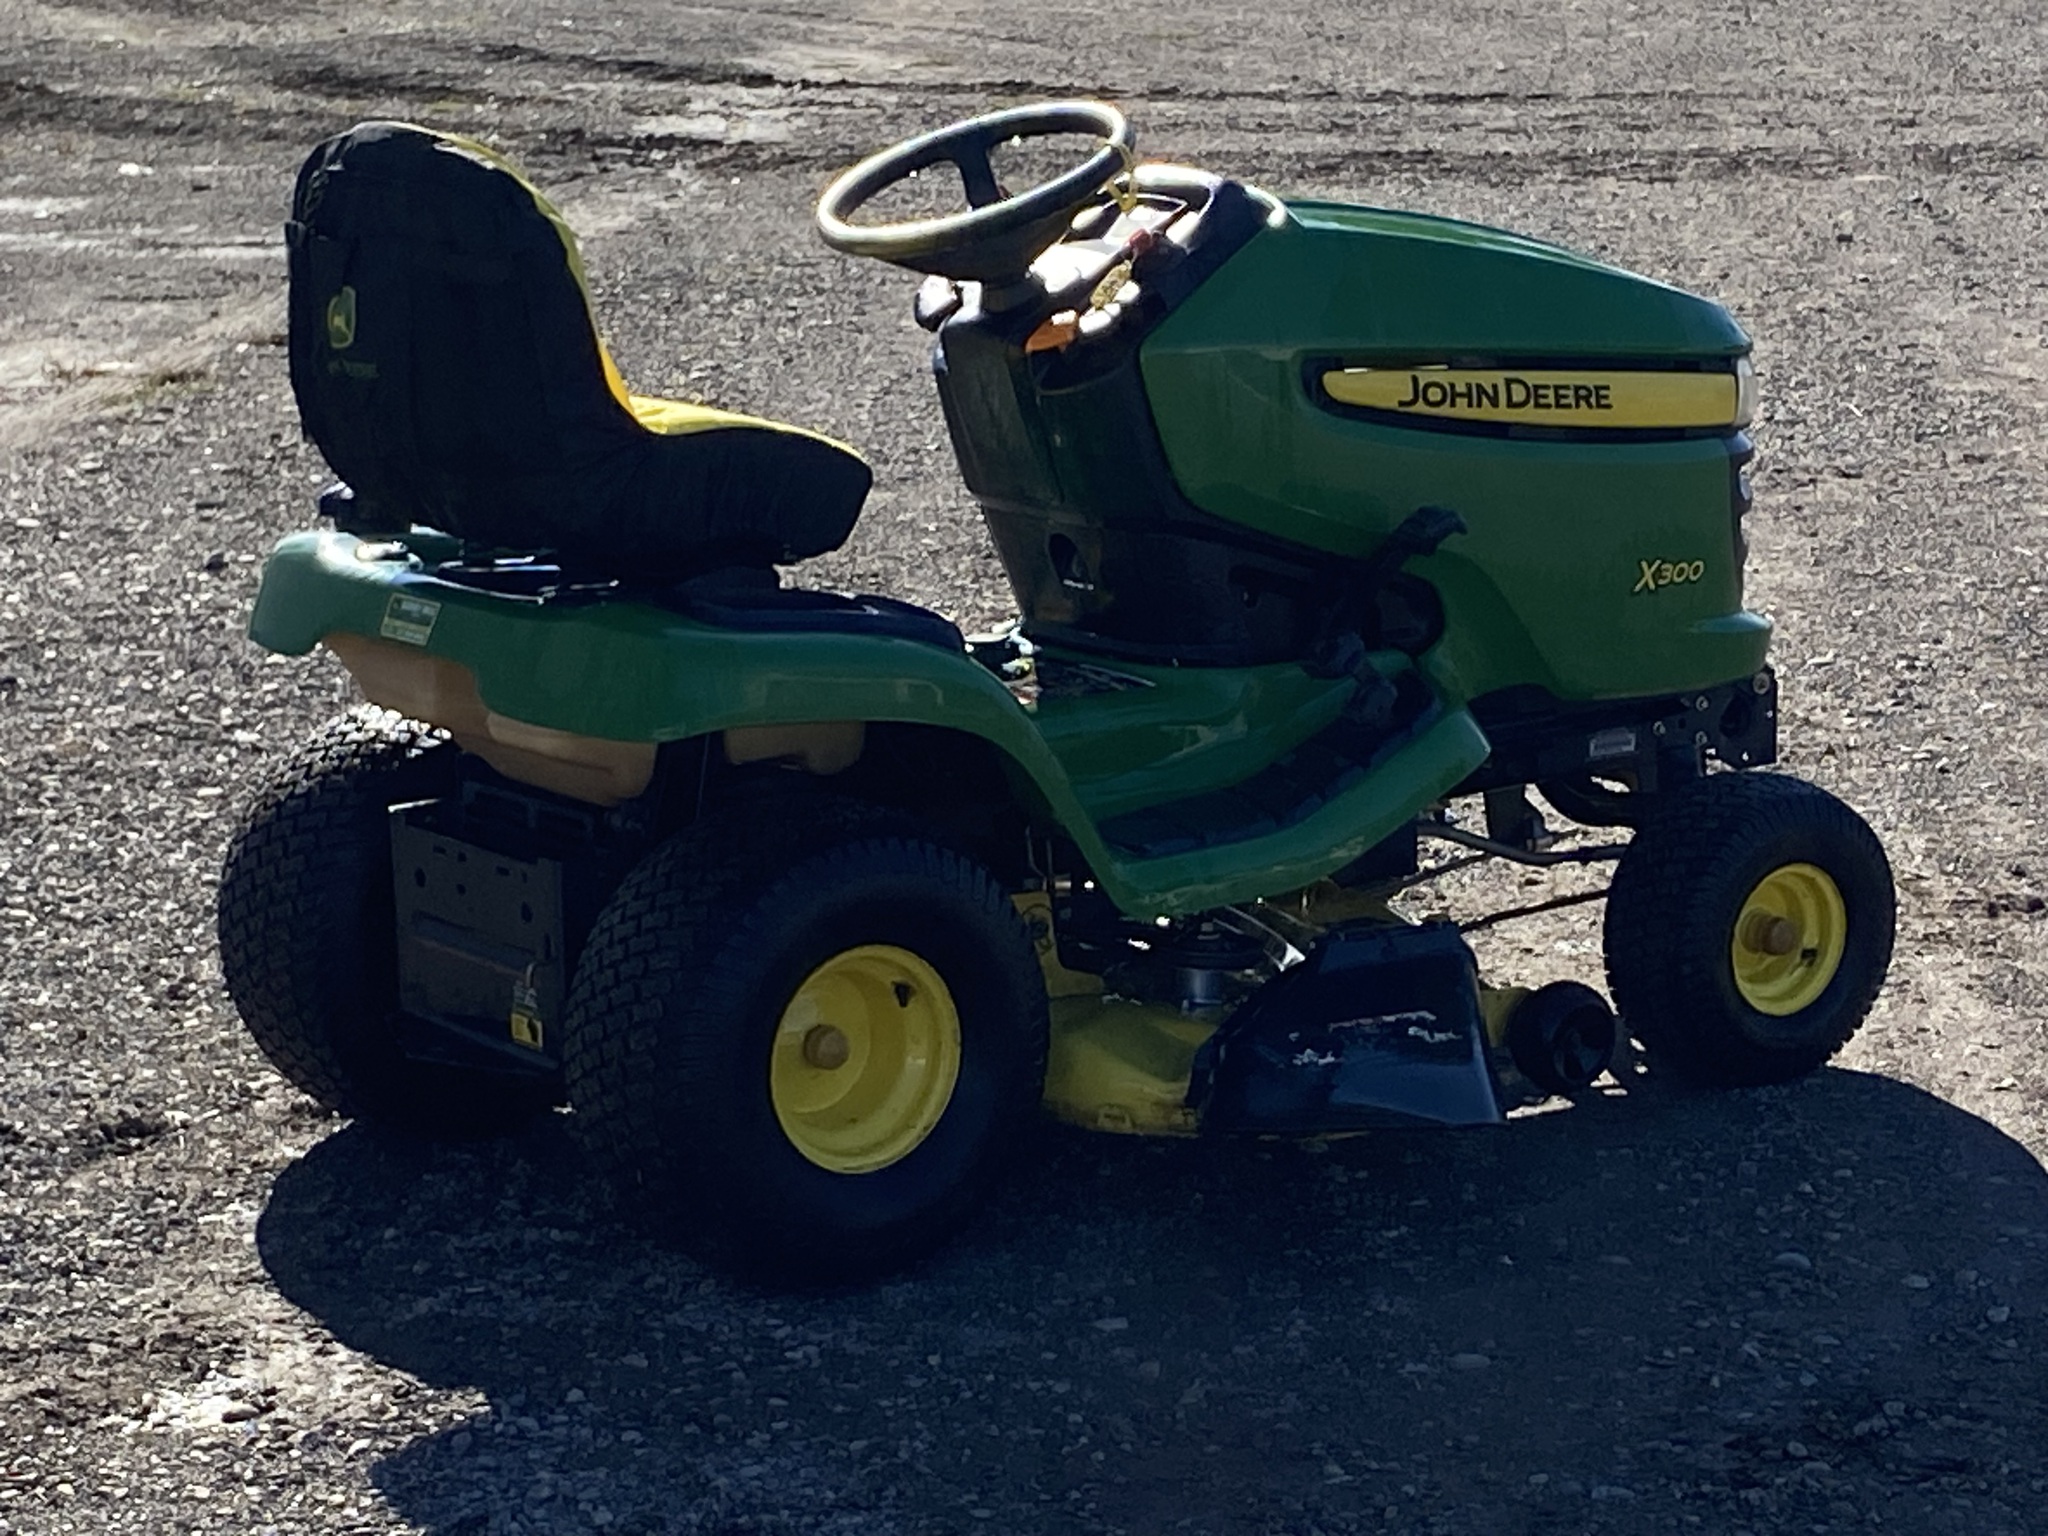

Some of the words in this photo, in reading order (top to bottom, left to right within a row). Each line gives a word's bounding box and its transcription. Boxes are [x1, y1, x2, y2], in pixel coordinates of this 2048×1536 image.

[1398, 374, 1499, 408] JOHN
[1504, 377, 1613, 409] DEERE
[1633, 559, 1704, 592] X300
